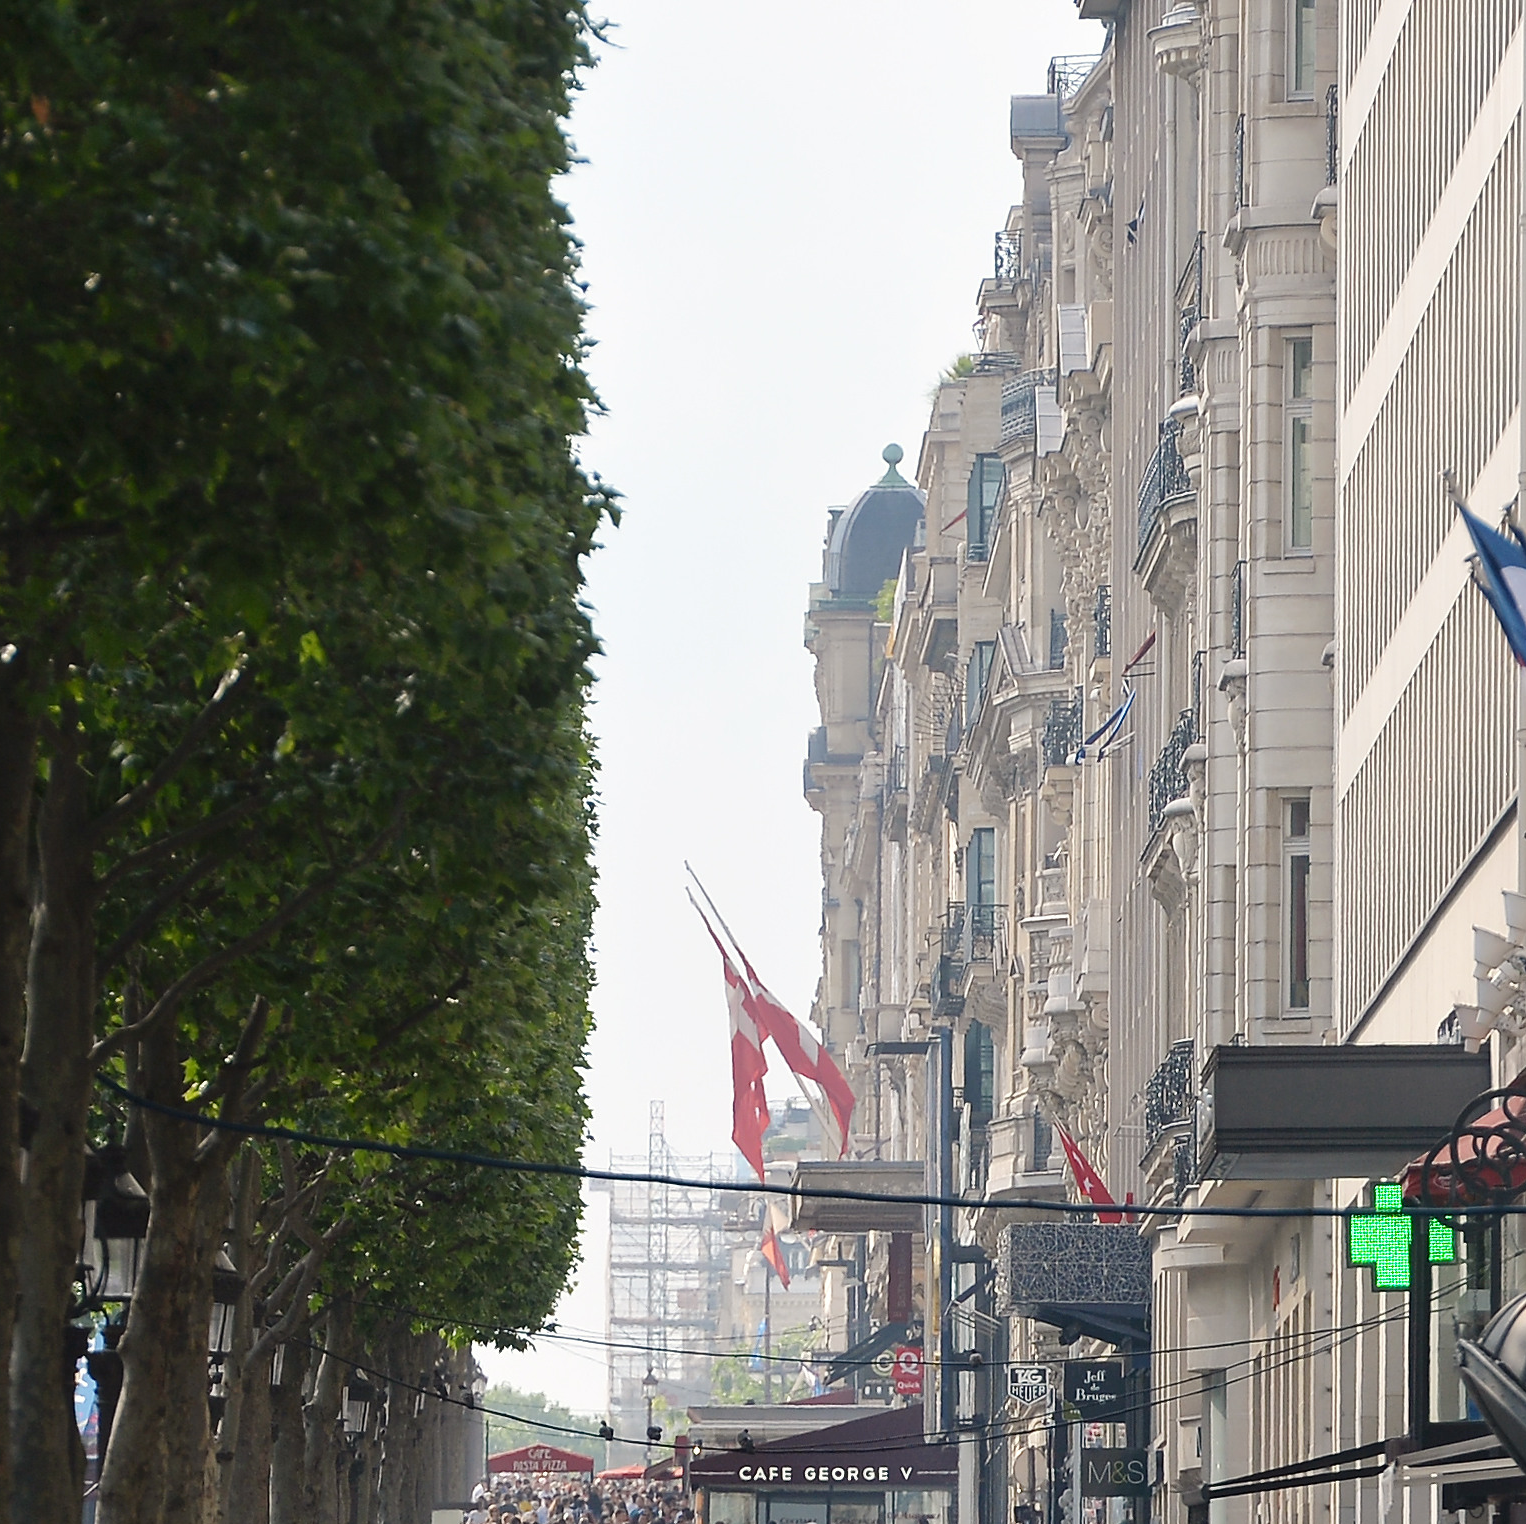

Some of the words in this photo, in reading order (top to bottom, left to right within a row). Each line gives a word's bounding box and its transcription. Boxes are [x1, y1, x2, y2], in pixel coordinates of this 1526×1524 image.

[1015, 1369, 1043, 1384] TAG
[1084, 1370, 1107, 1384] Jeff
[897, 1381, 920, 1389] Quick
[1011, 1386, 1046, 1402] HEUER
[1075, 1388, 1116, 1404] Bruges
[738, 1466, 793, 1481] CAFE
[804, 1466, 889, 1481] GEORGE
[900, 1466, 913, 1480] V
[1088, 1460, 1145, 1484] M&S
